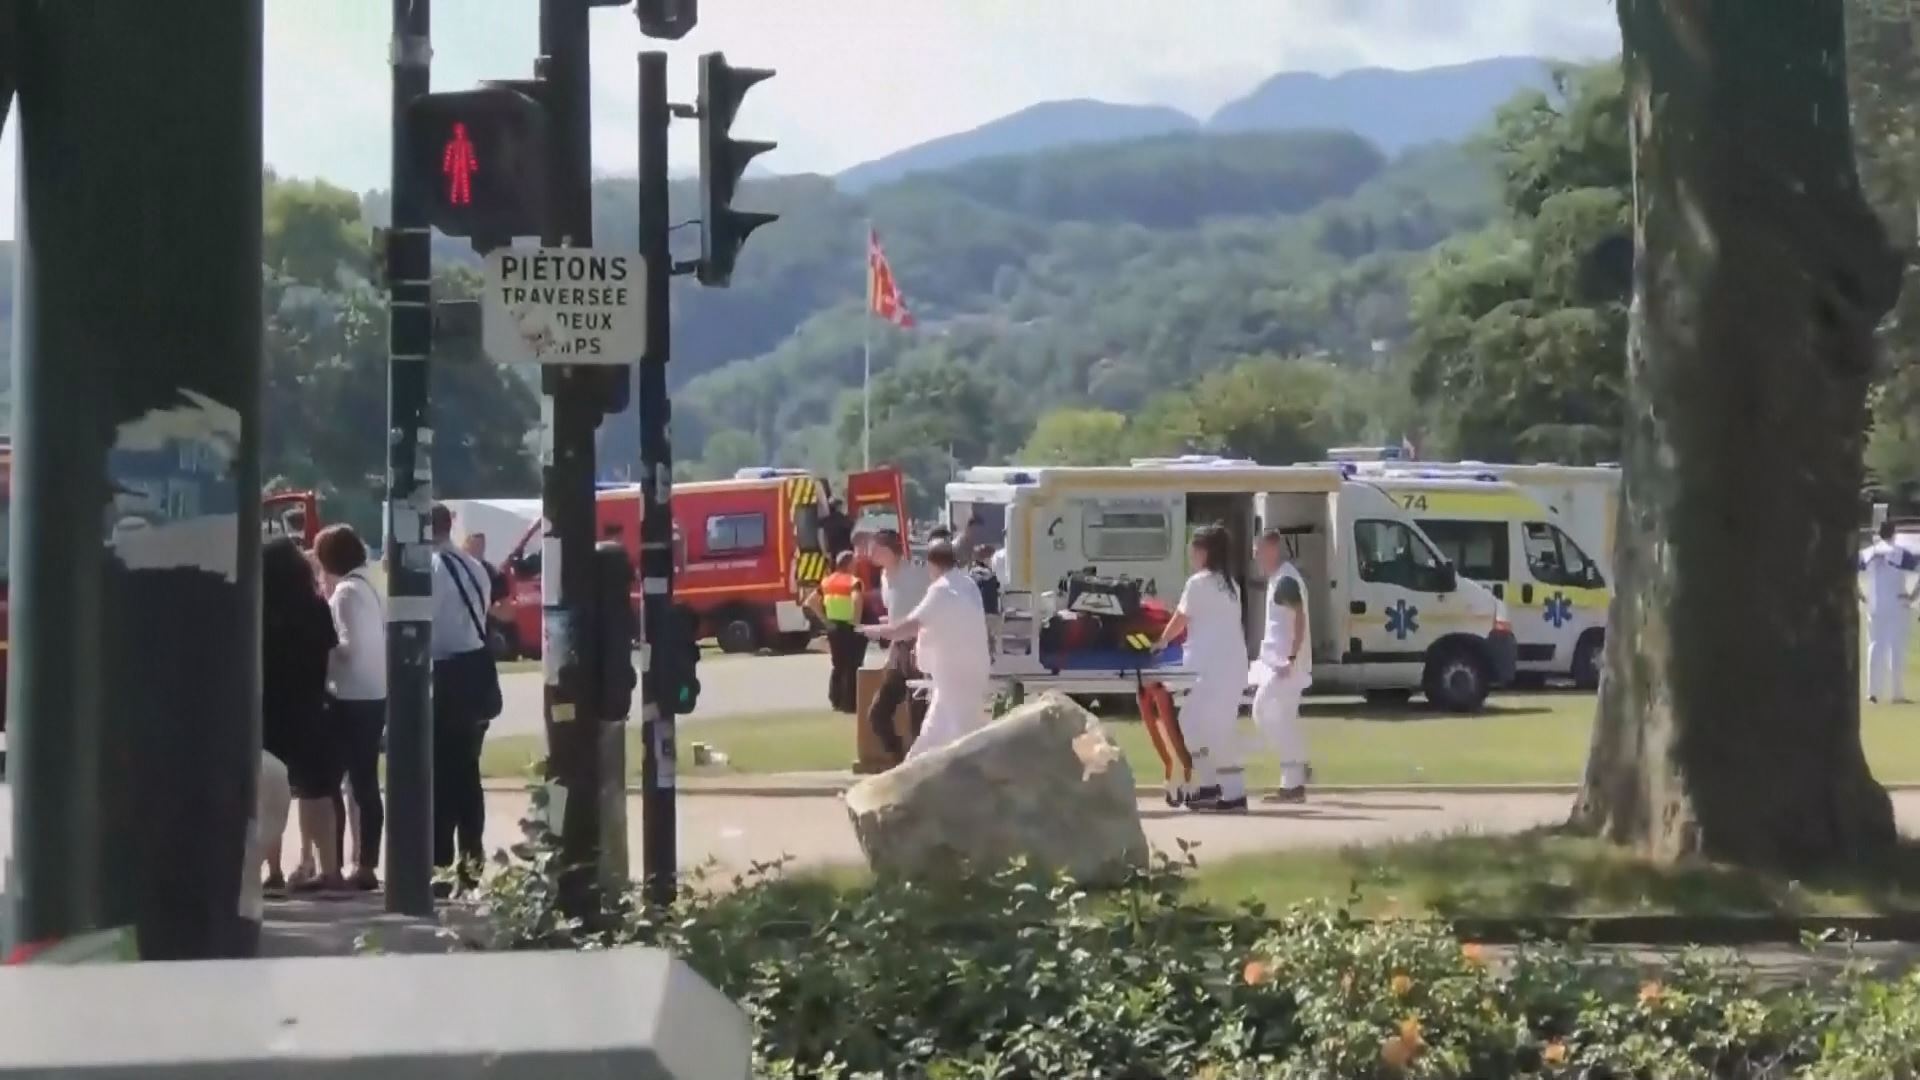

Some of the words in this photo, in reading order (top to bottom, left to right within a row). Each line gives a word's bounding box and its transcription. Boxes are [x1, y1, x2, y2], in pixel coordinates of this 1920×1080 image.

[502, 250, 627, 281] PIÉTONS
[502, 286, 628, 305] TRAVERSÉE
[1403, 495, 1429, 511] 74
